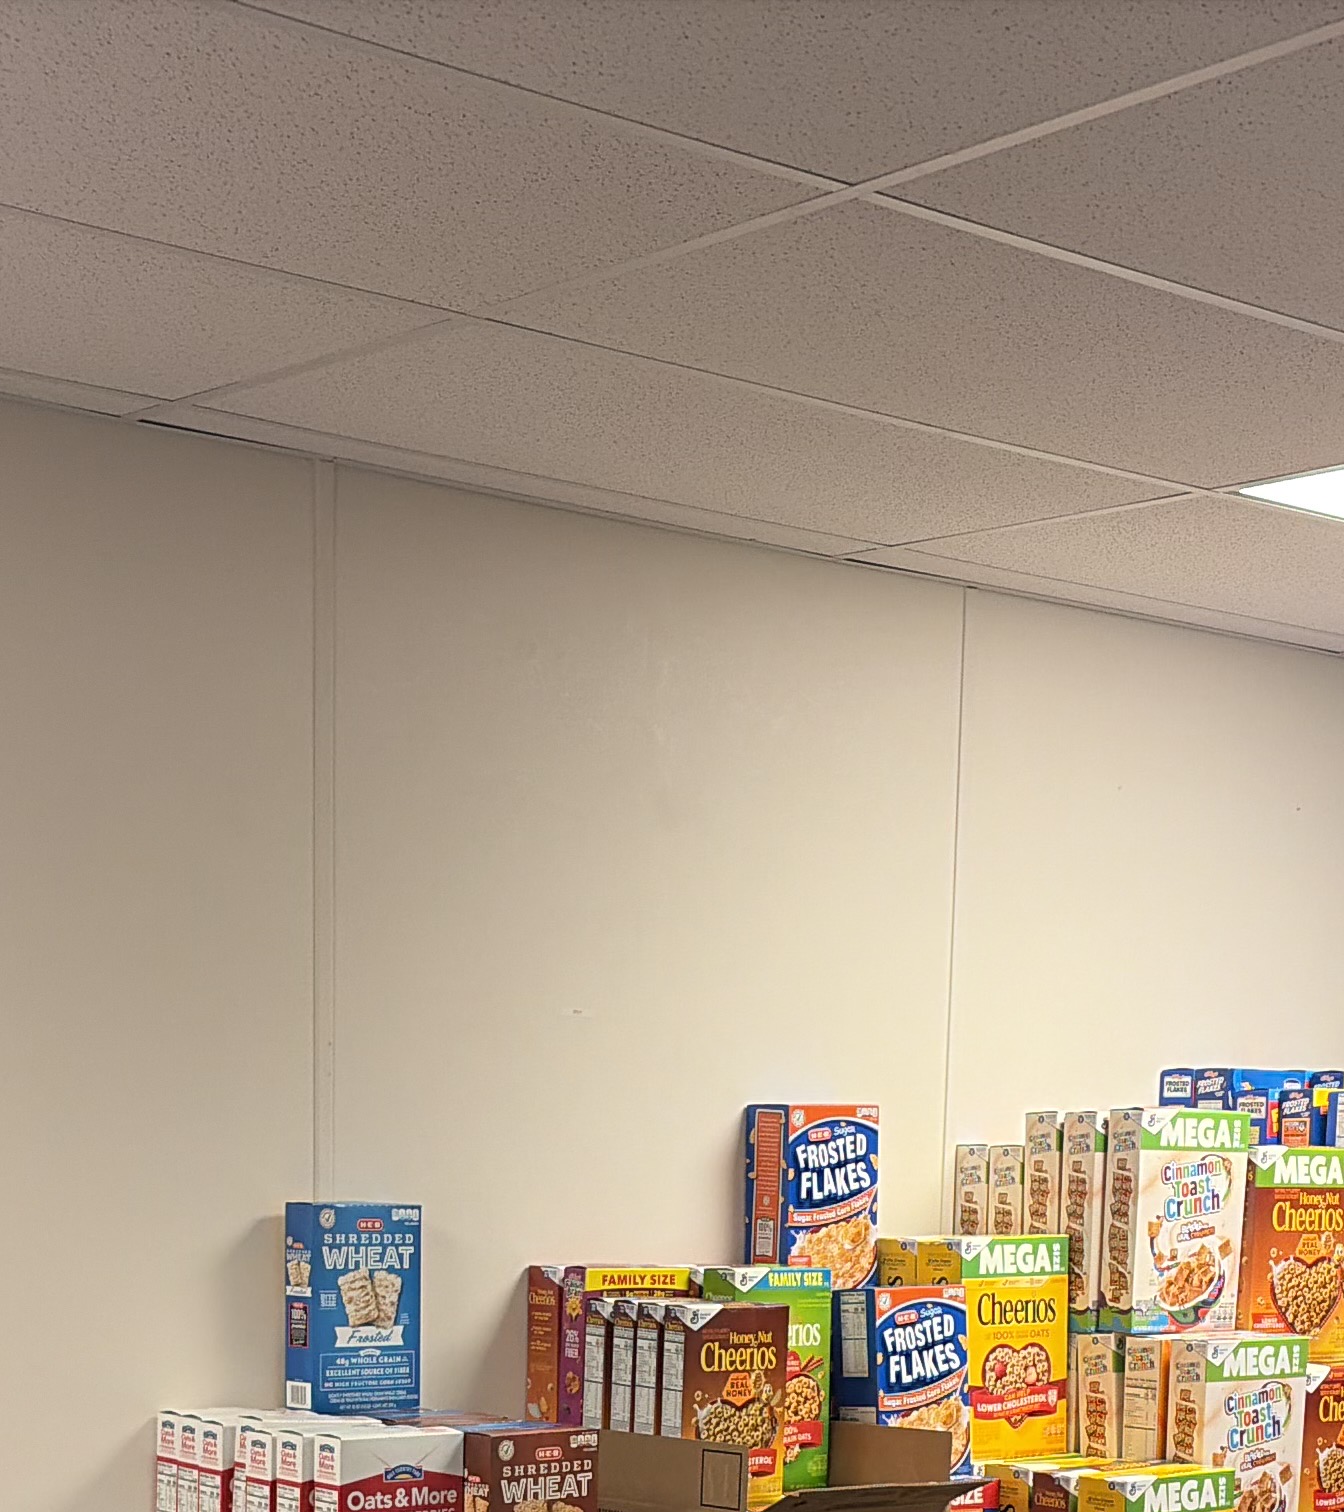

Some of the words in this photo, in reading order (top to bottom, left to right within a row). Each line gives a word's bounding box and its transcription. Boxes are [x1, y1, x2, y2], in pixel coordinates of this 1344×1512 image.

[1166, 1080, 1190, 1088] FROSTED
[1160, 1116, 1232, 1148] MEGA
[796, 1134, 867, 1168] FROSTED
[800, 1162, 870, 1200] FLAKES
[1161, 1160, 1222, 1183] Cinnamon
[1274, 1154, 1342, 1184] MEGA
[1174, 1177, 1212, 1198] Toast
[1166, 1192, 1221, 1221] Crunch
[1272, 1203, 1344, 1233] Cheerios
[324, 1234, 414, 1244] SHREDDED
[322, 1246, 414, 1270] WHEAT
[980, 1244, 1053, 1274] MEGA
[602, 1274, 646, 1286] FAMILY
[648, 1273, 676, 1286] SIZE
[768, 1272, 800, 1286] FAMILY
[804, 1272, 823, 1286] SIZE
[978, 1292, 1056, 1326] Cheerios
[730, 1332, 756, 1346] Honey
[758, 1331, 772, 1343] Nut
[883, 1314, 954, 1352] FROSTED
[993, 1331, 1014, 1340] 100%
[1030, 1329, 1050, 1338] OATS
[700, 1342, 776, 1372] Cheerios
[889, 1342, 960, 1384] FLAKES
[1222, 1344, 1290, 1378] MEGA
[978, 1402, 1002, 1412] LOWER
[1003, 1395, 1046, 1410] CHOLESTEROL
[537, 1450, 560, 1458] H-E-B
[503, 1460, 592, 1478] SHREDDED
[347, 1490, 392, 1511] Oats
[395, 1488, 409, 1508] &
[412, 1486, 458, 1506] More
[500, 1474, 592, 1504] WHEAT
